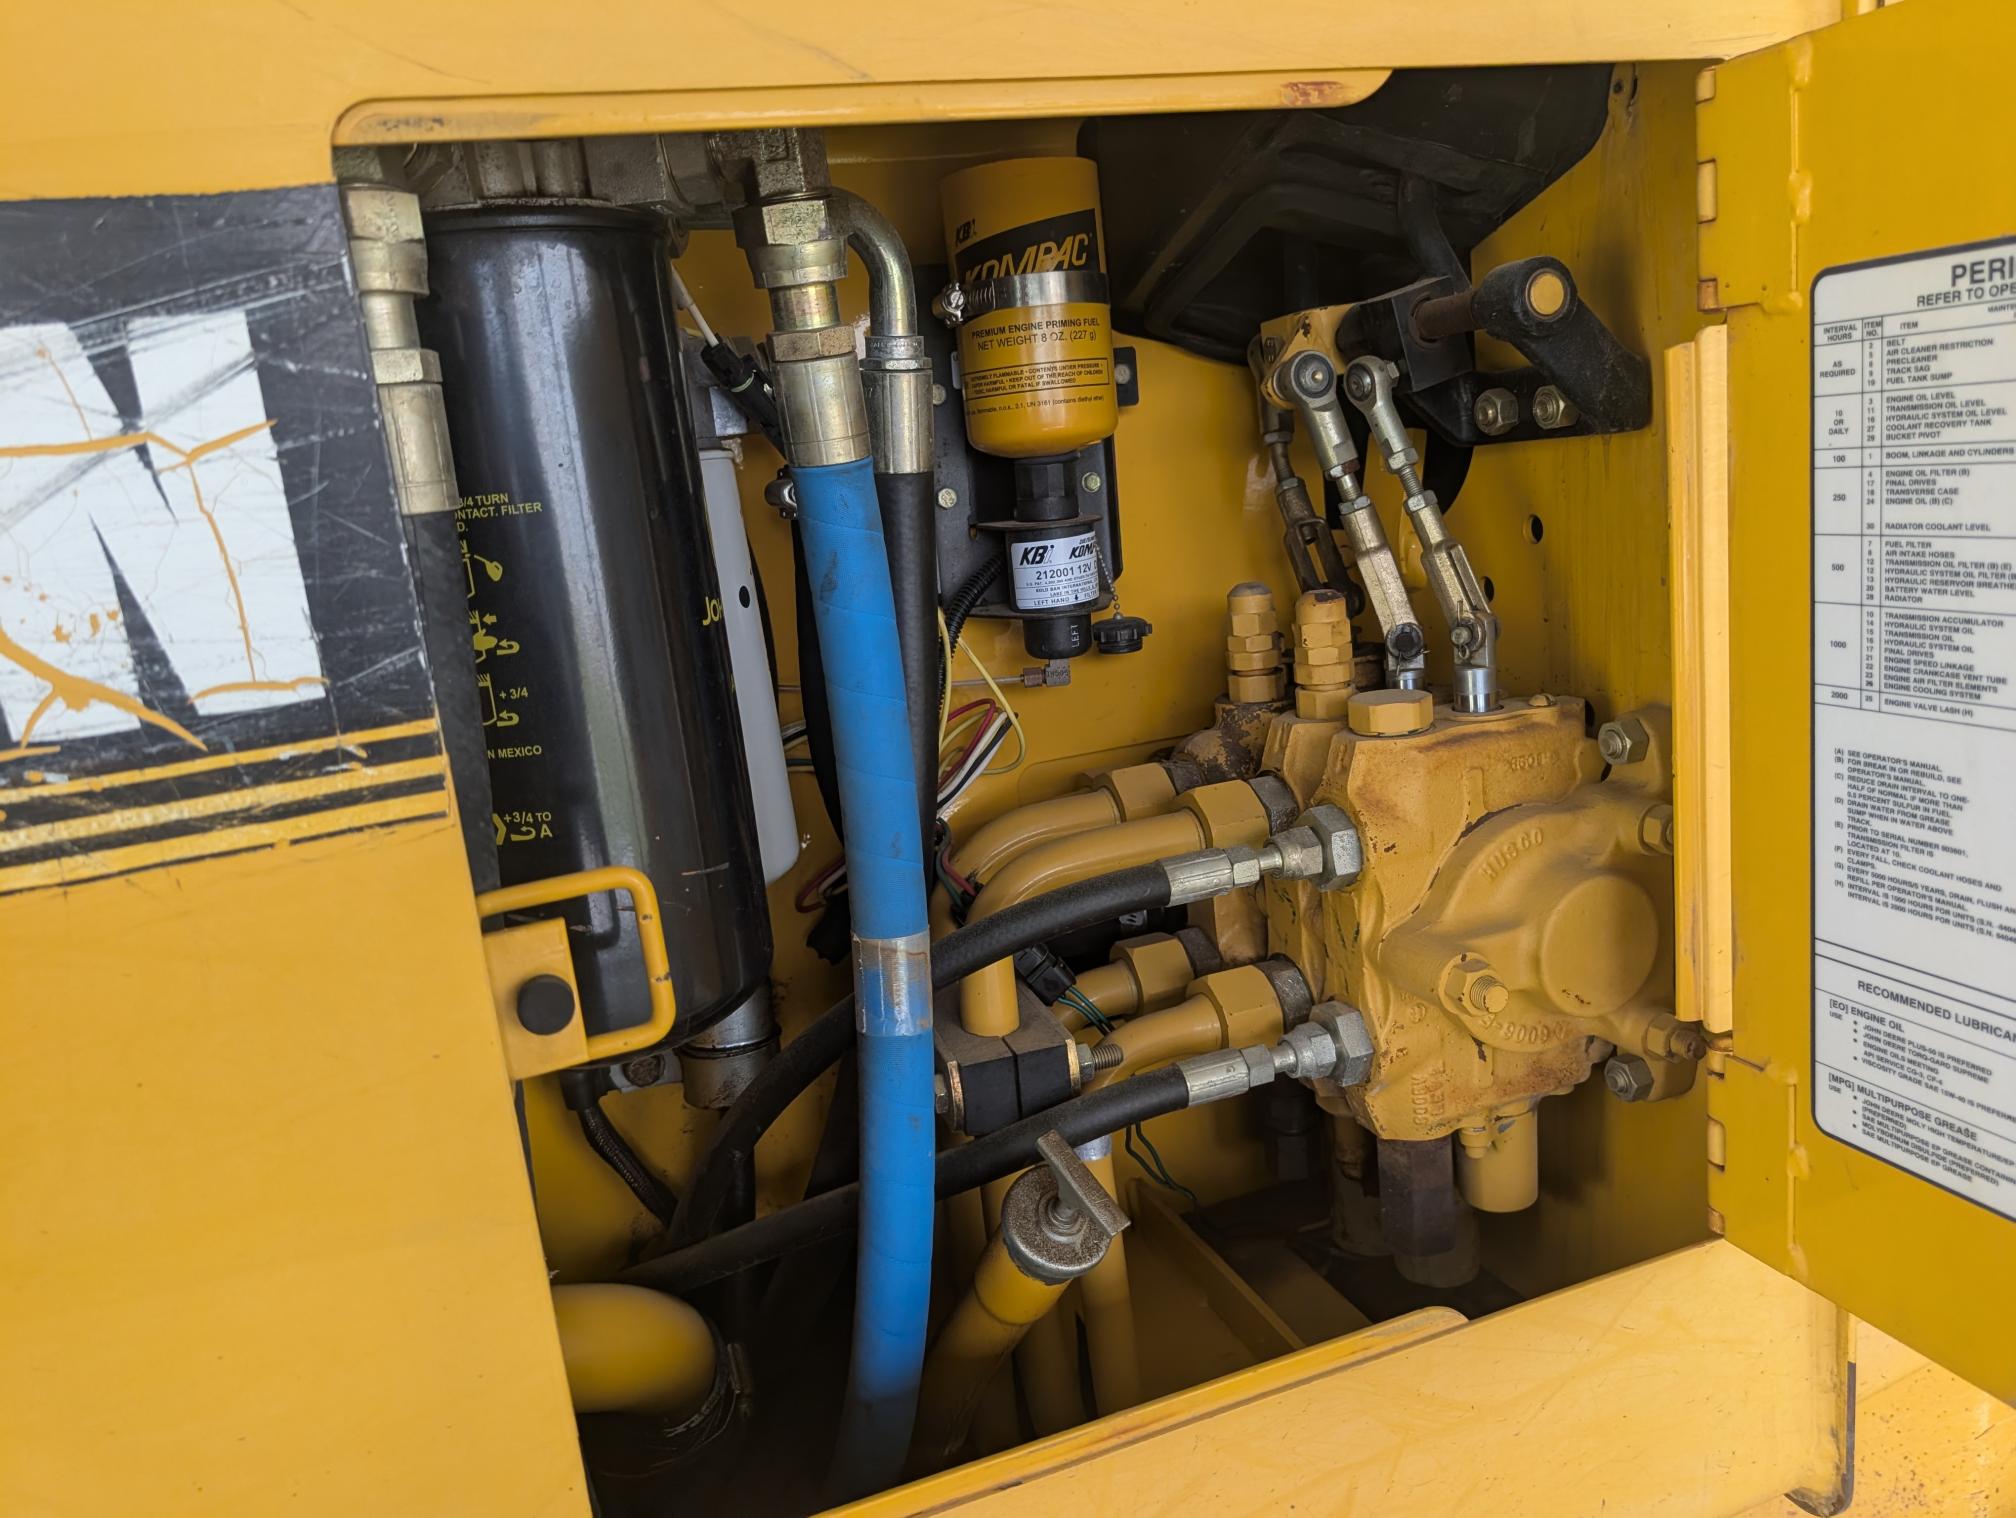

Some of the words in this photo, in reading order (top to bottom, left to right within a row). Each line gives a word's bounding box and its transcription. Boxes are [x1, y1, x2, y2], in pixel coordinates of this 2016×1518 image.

[1951, 254, 2015, 288] PERI
[1916, 289, 1961, 307] REFER
[1966, 286, 1984, 301] TO
[972, 326, 1006, 339] PREMIUM
[1008, 322, 1043, 334] ENGINE
[1046, 319, 1081, 328] PRIMING
[1084, 318, 1100, 326] FUEL
[1823, 323, 1857, 334] INTERVAL
[1863, 320, 1881, 329] ITEM
[1900, 320, 1918, 330] ITEM
[1827, 332, 1852, 342] HOURS
[1865, 328, 1878, 337] NO.
[977, 339, 994, 351] NET
[997, 334, 1038, 348] WEIGHT
[1041, 333, 1047, 342] 8
[1050, 332, 1067, 341] OZ.
[1070, 330, 1087, 342] (227
[1089, 331, 1096, 341] g)
[1886, 337, 1905, 347] BELT
[1886, 348, 1899, 356] AIR
[1900, 343, 1937, 355] CLEANER
[1938, 337, 1993, 351] RESTRICTION
[1832, 360, 1842, 368] AS
[1886, 353, 1937, 366] PRECLEANER
[1819, 367, 1855, 378] REQUIRED
[1886, 365, 1912, 375] TRACK
[1913, 363, 1930, 373] SAG
[1886, 375, 1904, 385] FUEL
[1907, 373, 1928, 382] TANK
[1929, 371, 1952, 381] SUMP
[1885, 394, 1914, 404] ENGINE
[1915, 393, 1928, 402] OIL
[1930, 390, 1954, 400] LEVEL
[1886, 401, 1943, 413] TRANSMISSION
[1944, 400, 1957, 409] OIL
[1960, 398, 1984, 408] LEVEL
[1835, 409, 1843, 417] 10
[1885, 412, 1929, 422] HYDRAULIC
[1930, 409, 1963, 419] SYSTEM
[1964, 408, 1978, 417] OIL
[1980, 407, 2006, 416] LEVEL
[1833, 418, 1844, 426] OR
[1885, 422, 1922, 432] COOLANT
[1923, 419, 1967, 429] RECOVERY
[1970, 418, 1991, 426] TANK
[1828, 427, 1848, 435] DAILY
[1885, 431, 1916, 440] BUCKET
[1917, 430, 1940, 439] PIVOT
[1833, 454, 1845, 462] 100
[1885, 450, 1910, 459] BOOM,
[1911, 449, 1946, 458] LINKAGE
[1948, 448, 1965, 457] AND
[1966, 446, 2014, 456] CYLINDERS
[1885, 469, 1913, 477] ENGINE
[1914, 469, 1927, 477] OIL
[1929, 468, 1957, 476] FILTER
[1958, 468, 1970, 476] (B)
[1908, 478, 1936, 486] DRIVES
[1832, 493, 1846, 501] 250
[1886, 487, 1935, 495] TRANSVERSE
[1937, 487, 1958, 495] CASE
[475, 493, 509, 505] TURN
[456, 506, 498, 519] NTACT.
[501, 502, 542, 516] FILTER
[1884, 522, 1923, 530] RADIATOR
[1924, 522, 1963, 531] COOLANT
[1964, 523, 1990, 531] LEVEL
[1884, 540, 1903, 548] FUEL
[1905, 540, 1931, 549] FILTER
[1898, 550, 1926, 558] INTAKE
[1928, 550, 1955, 559] HOSES
[1036, 566, 1074, 580] 212001
[1078, 561, 1092, 574] 12V
[1831, 563, 1844, 571] 500
[1884, 584, 1918, 594] BATTERY
[1920, 586, 1948, 595] WATER
[1949, 588, 1974, 597] LEVEL
[1884, 594, 1922, 603] RADIATOR
[1885, 612, 1940, 623] TRANSMISSION
[1941, 616, 2003, 628] ACCUMULATOR
[1070, 624, 1080, 648] LEFT
[1830, 639, 1846, 648] 1000
[1883, 646, 1904, 656] FINAL
[1906, 648, 1934, 659] DRIVES
[1883, 655, 1911, 665] ENGINE
[1913, 658, 1938, 668] SPEED
[1939, 661, 1974, 672] LINKAGE
[509, 687, 528, 700] 3/4
[1831, 690, 1848, 700] 2000
[1883, 681, 1910, 692] ENGINE
[1912, 685, 1947, 696] COOLING
[1949, 689, 1980, 700] SYSTEM
[498, 745, 542, 758] MEXICO
[503, 811, 533, 825] +3/4
[536, 811, 552, 822] TO
[539, 824, 553, 838] A
[1857, 979, 1951, 1021] RECOMMENDED
[1829, 997, 1848, 1015] [EO]
[1850, 1005, 1886, 1026] ENGINE
[1888, 1018, 1904, 1033] OIL
[1828, 1071, 1854, 1092] [MPG]
[1856, 1083, 1931, 1123] MULTIPURPOSE
[1934, 1115, 1977, 1142] GREASE
